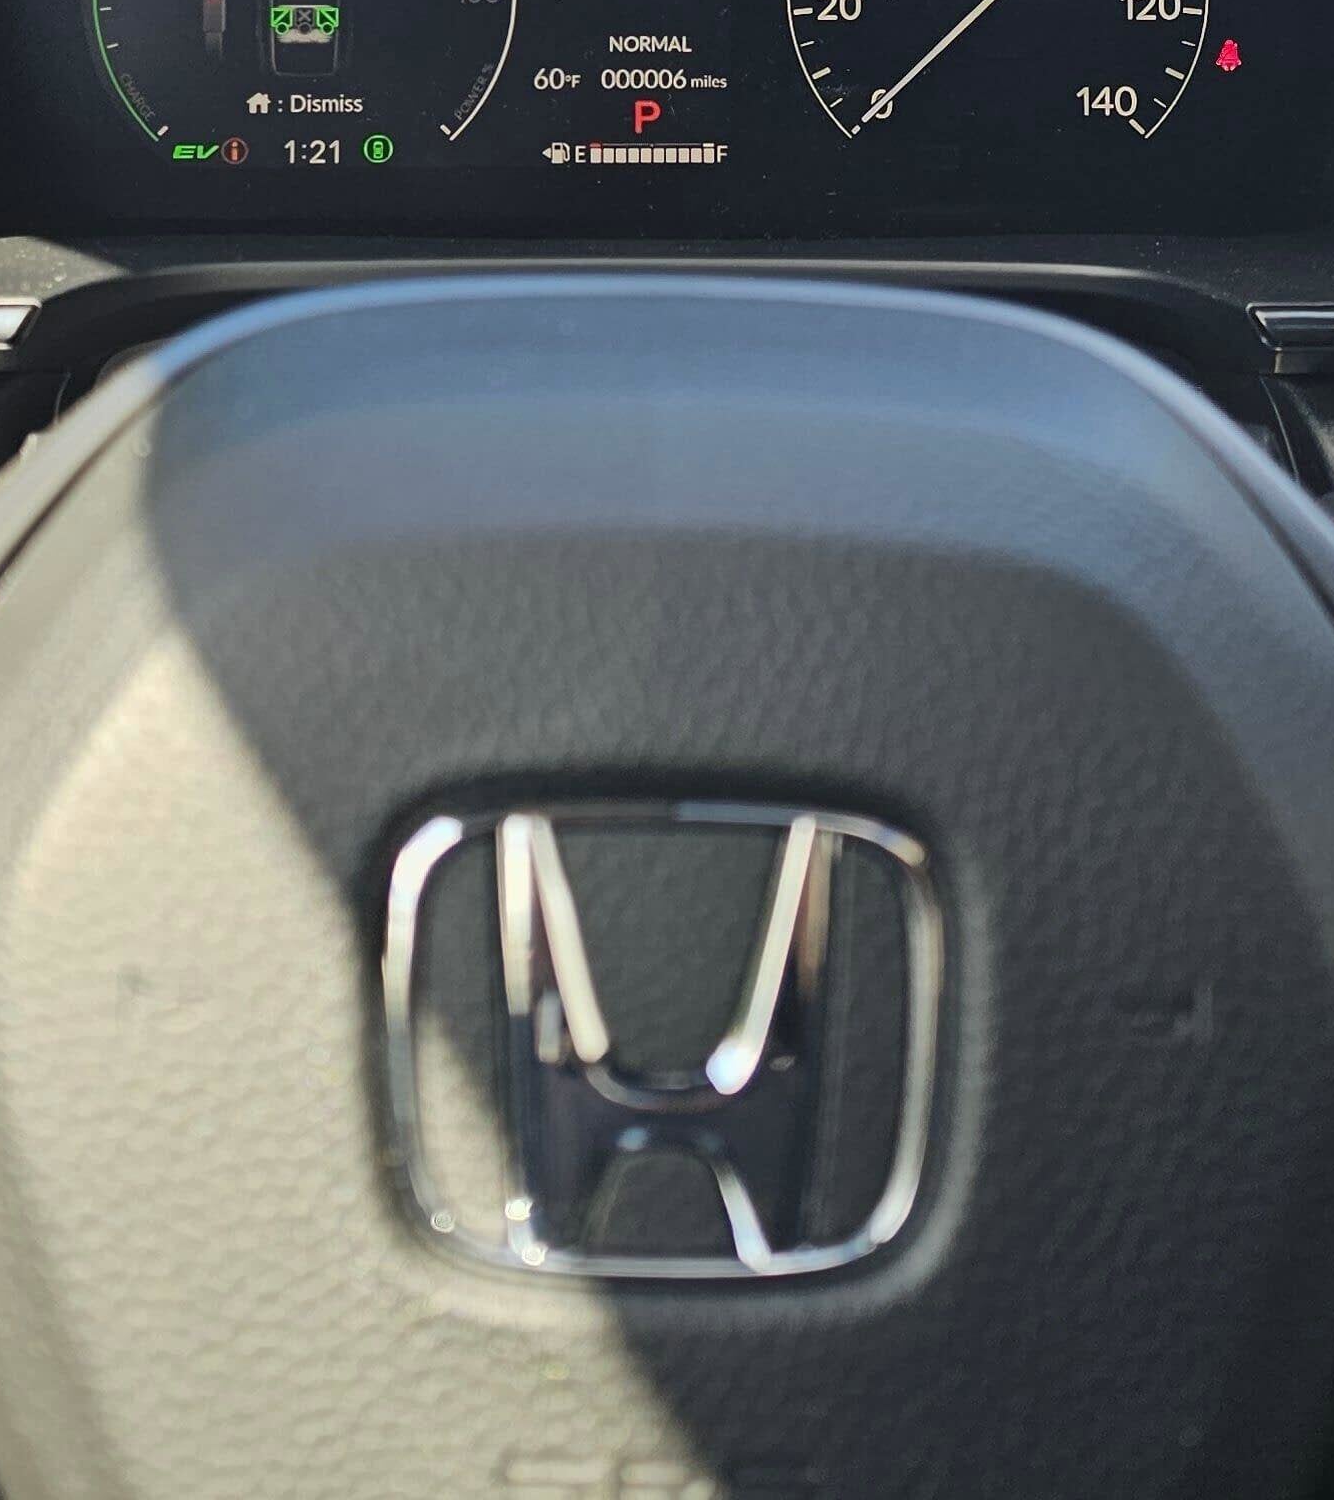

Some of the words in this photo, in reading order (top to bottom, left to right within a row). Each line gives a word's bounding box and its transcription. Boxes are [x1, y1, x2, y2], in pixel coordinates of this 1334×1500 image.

[609, 35, 693, 53] NORMAL
[601, 67, 687, 90] 000006
[690, 74, 728, 89] miles
[120, 73, 156, 122] CHARGE
[290, 94, 364, 113] Dismiss
[454, 76, 487, 120] POWER
[1075, 86, 1138, 117] 140
[633, 100, 661, 134] P
[172, 145, 220, 160] EV
[283, 139, 341, 165] 1:21
[574, 146, 586, 163] E
[716, 146, 728, 163] F
